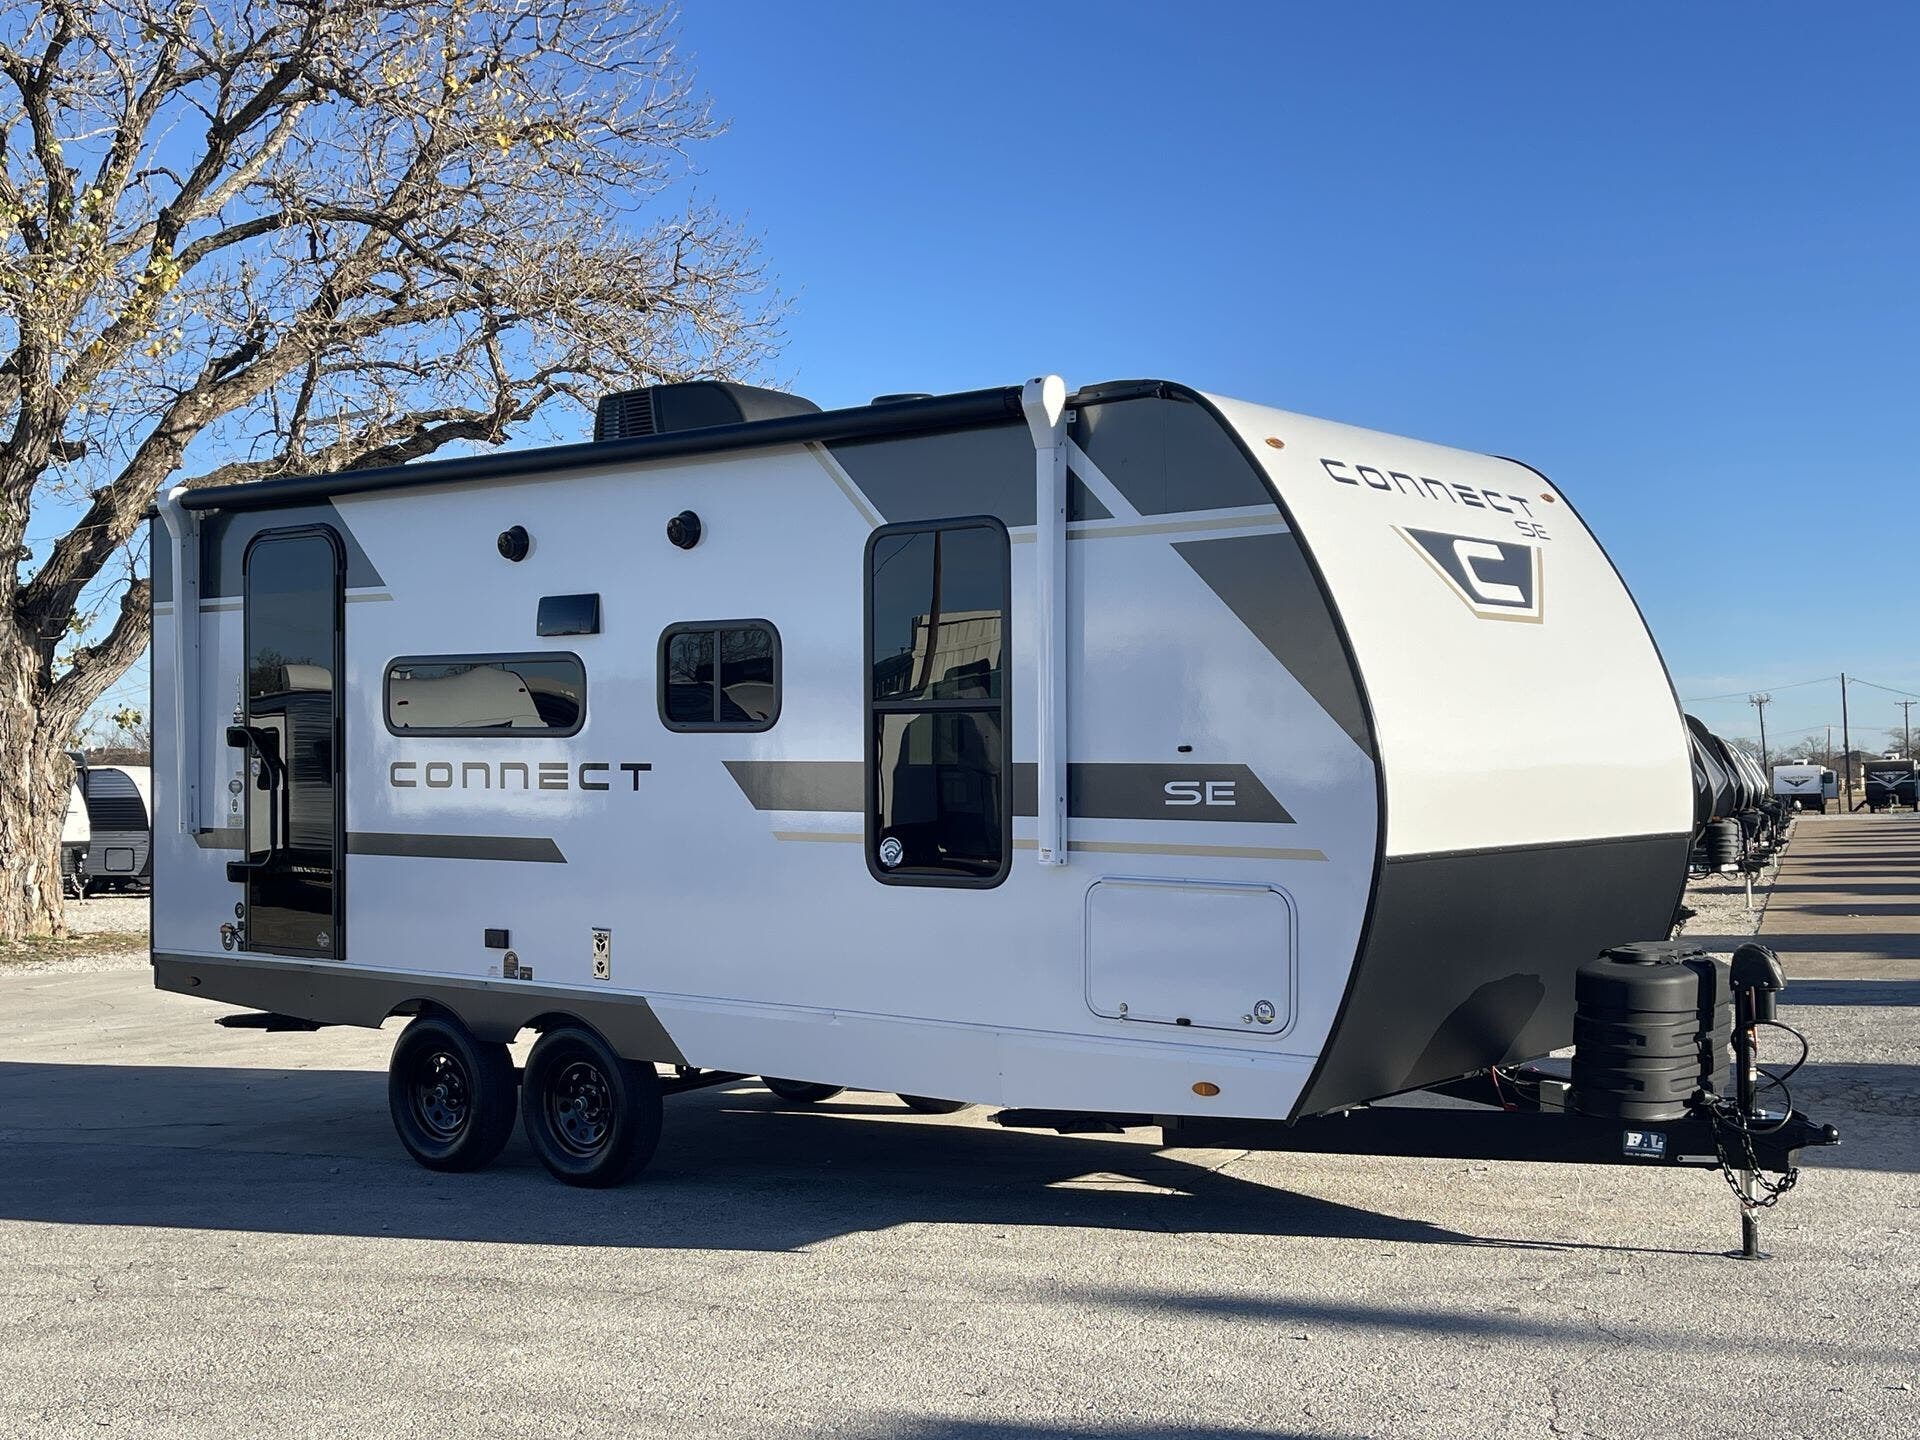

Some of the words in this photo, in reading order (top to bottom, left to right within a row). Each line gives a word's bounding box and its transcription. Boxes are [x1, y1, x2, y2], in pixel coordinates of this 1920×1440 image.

[1320, 458, 1533, 518] CONNECT
[1515, 520, 1551, 540] SE
[390, 762, 652, 791] CONNECT
[1165, 781, 1236, 806] SE
